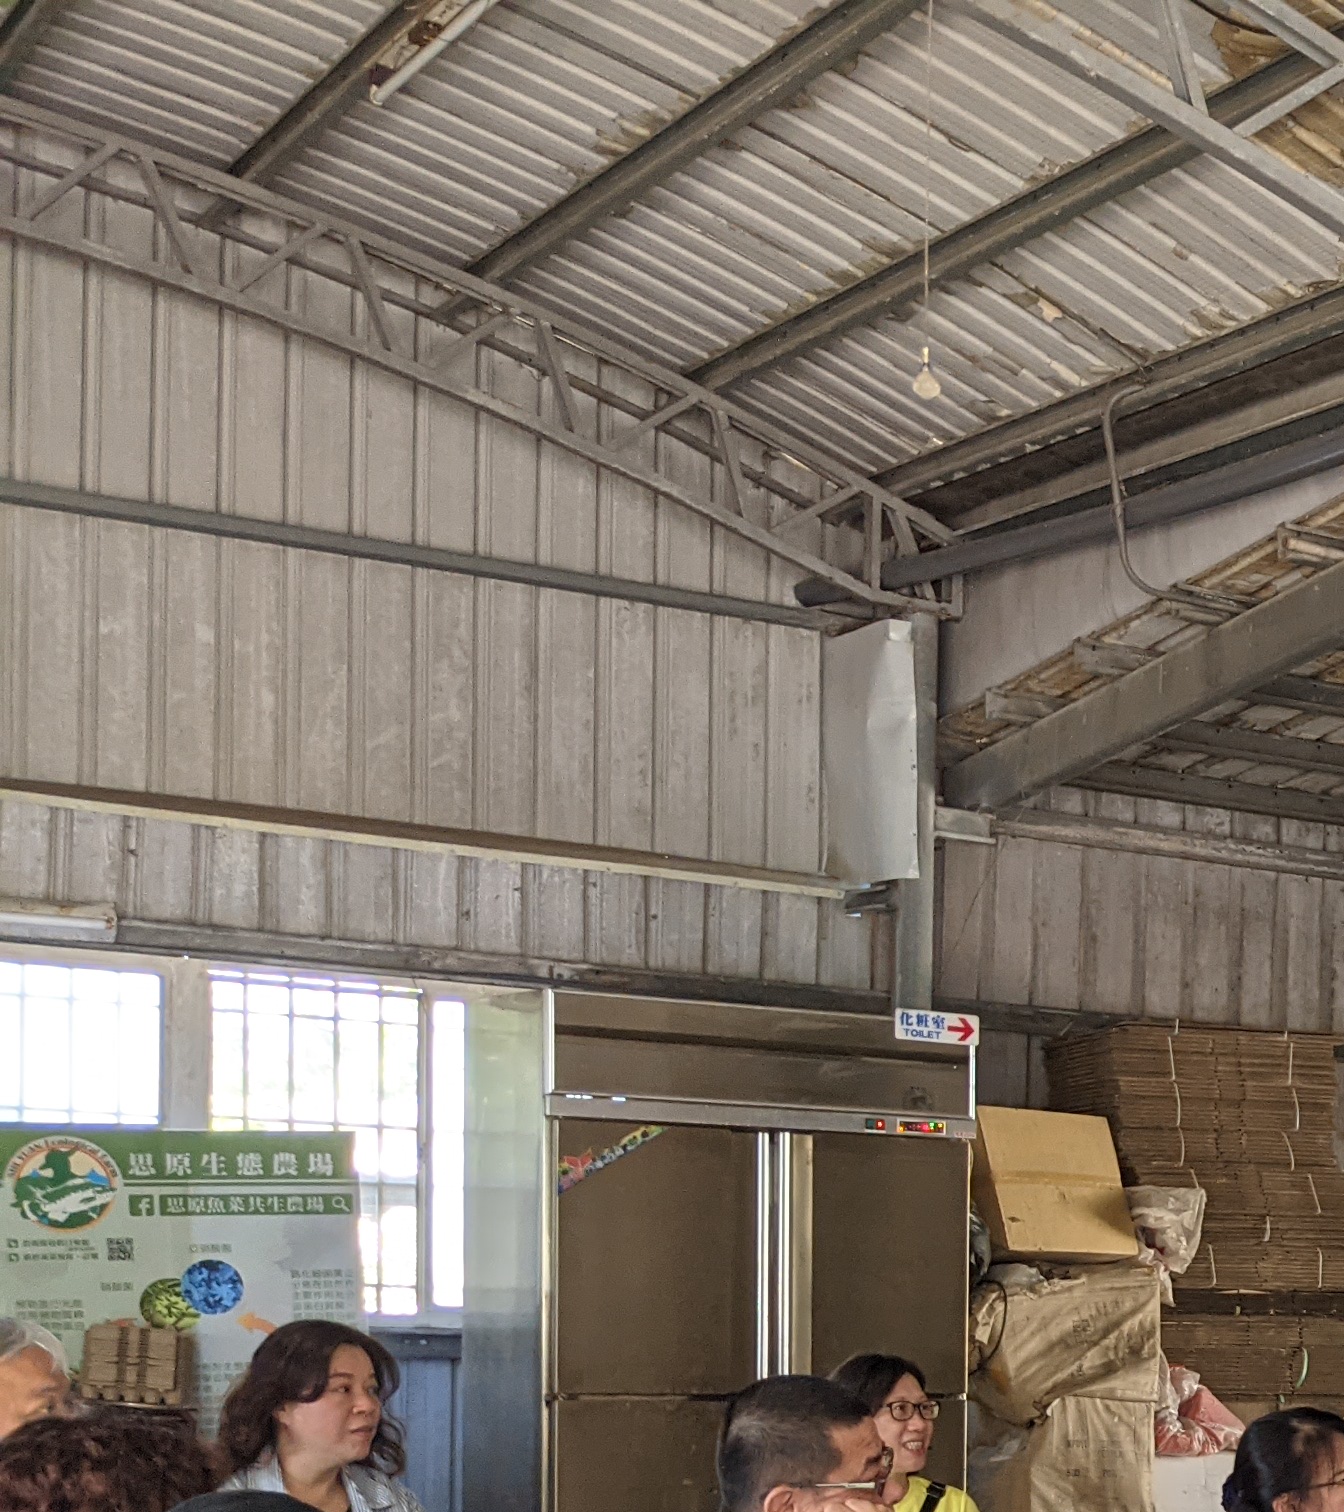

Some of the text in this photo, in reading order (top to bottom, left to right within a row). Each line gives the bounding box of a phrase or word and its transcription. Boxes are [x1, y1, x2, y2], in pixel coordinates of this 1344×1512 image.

[900, 1011, 946, 1030] 化粧室
[903, 1028, 942, 1040] TOILET
[128, 1151, 334, 1177] 思原生態農場
[167, 1196, 325, 1214] 思原魚菜共生農場
